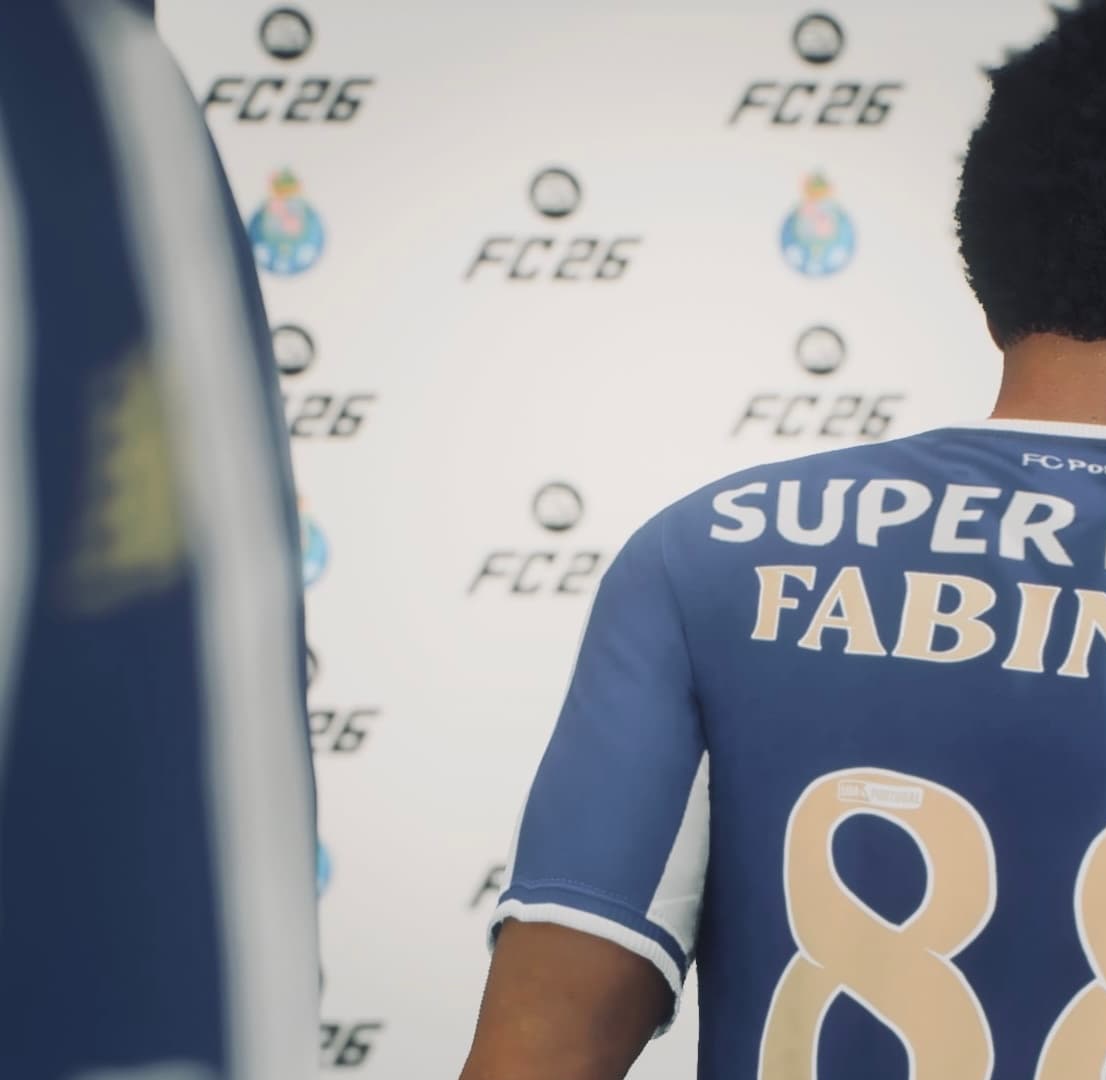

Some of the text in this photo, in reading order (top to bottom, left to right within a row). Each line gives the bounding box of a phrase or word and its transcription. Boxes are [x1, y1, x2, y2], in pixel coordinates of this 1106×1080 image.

[1022, 453, 1064, 470] FC
[710, 479, 1076, 566] SUPER
[467, 550, 603, 596] FC2
